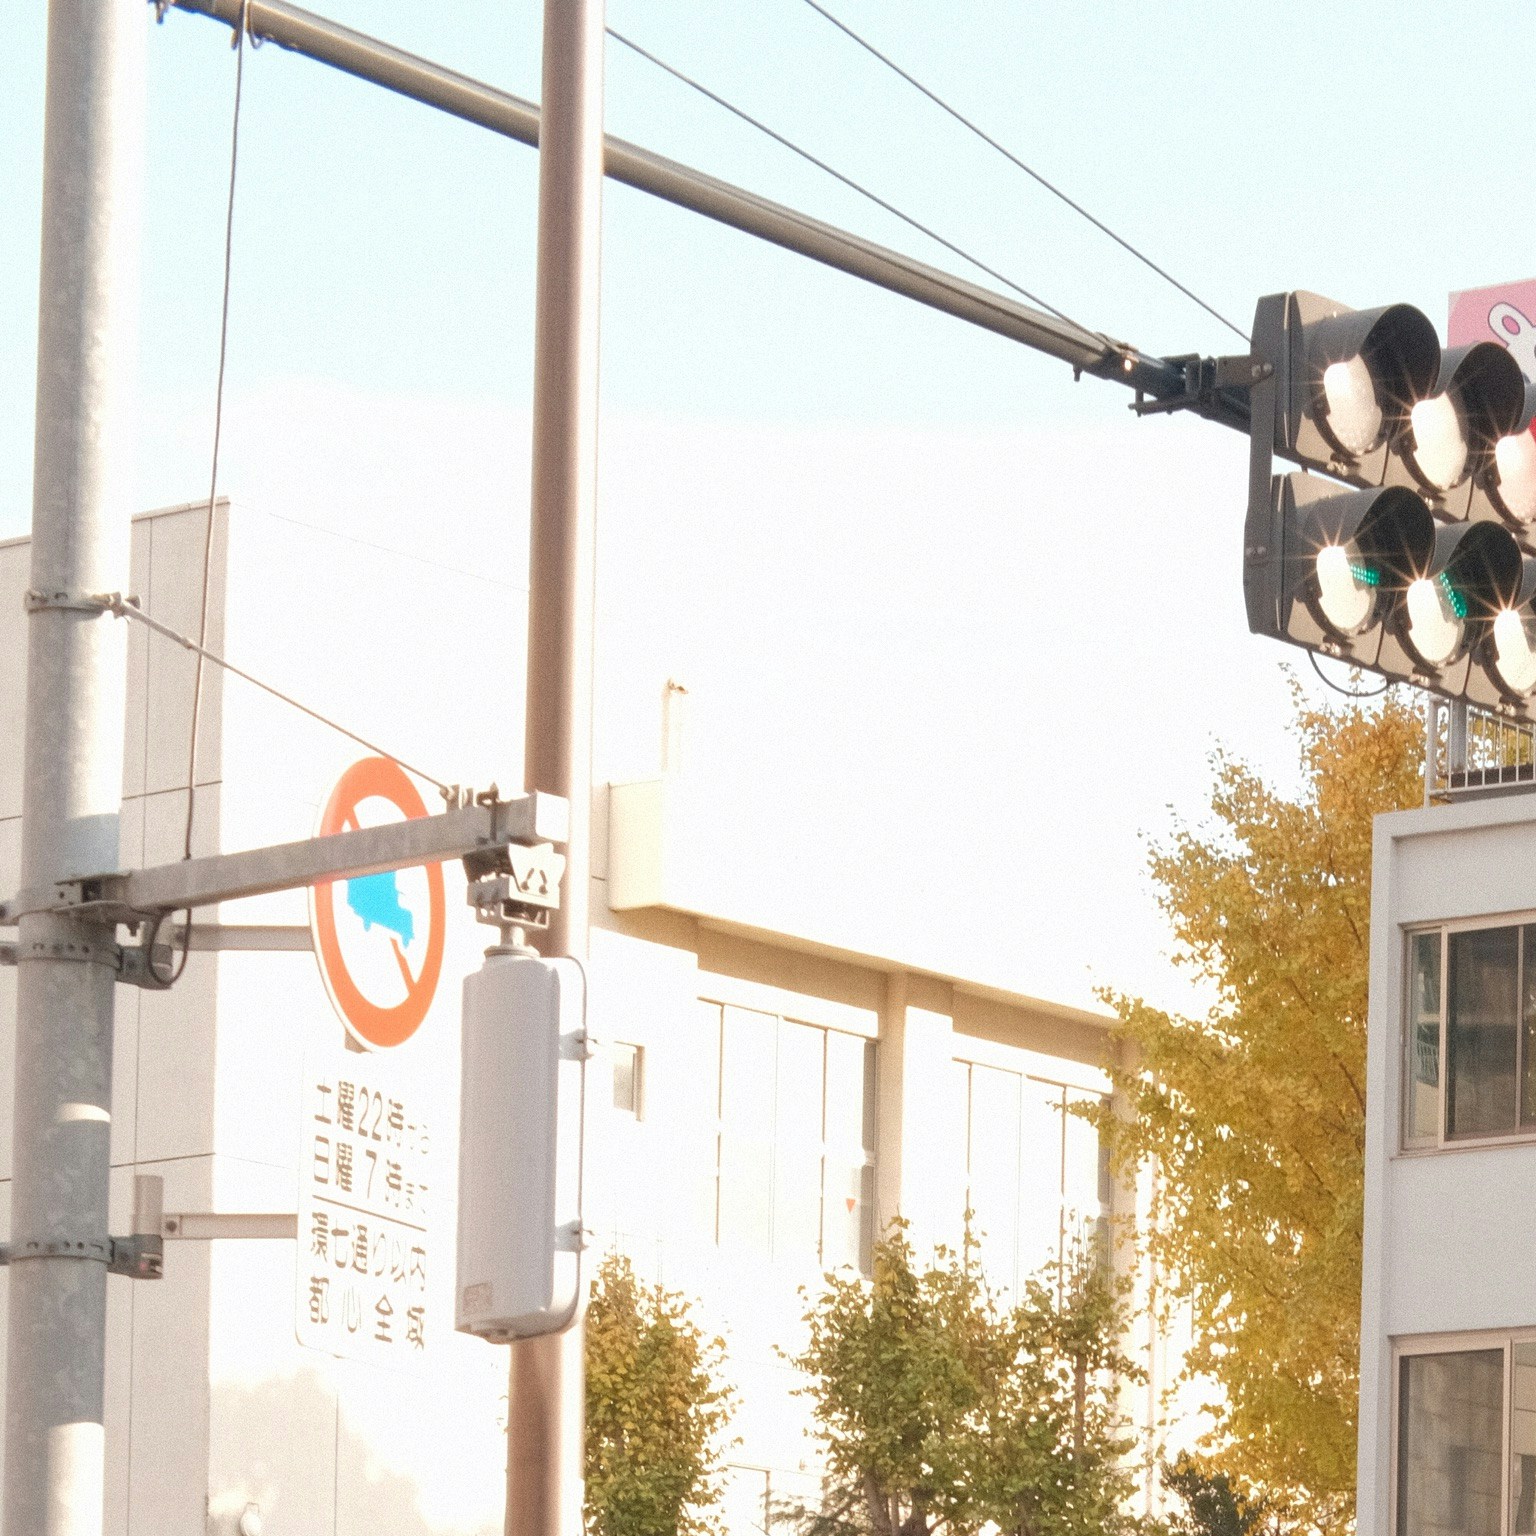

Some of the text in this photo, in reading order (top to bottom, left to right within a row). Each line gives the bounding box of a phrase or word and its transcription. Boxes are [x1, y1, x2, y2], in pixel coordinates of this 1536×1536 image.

[310, 1211, 427, 1293] 環七通り以内
[308, 1274, 425, 1351] 都心全域
